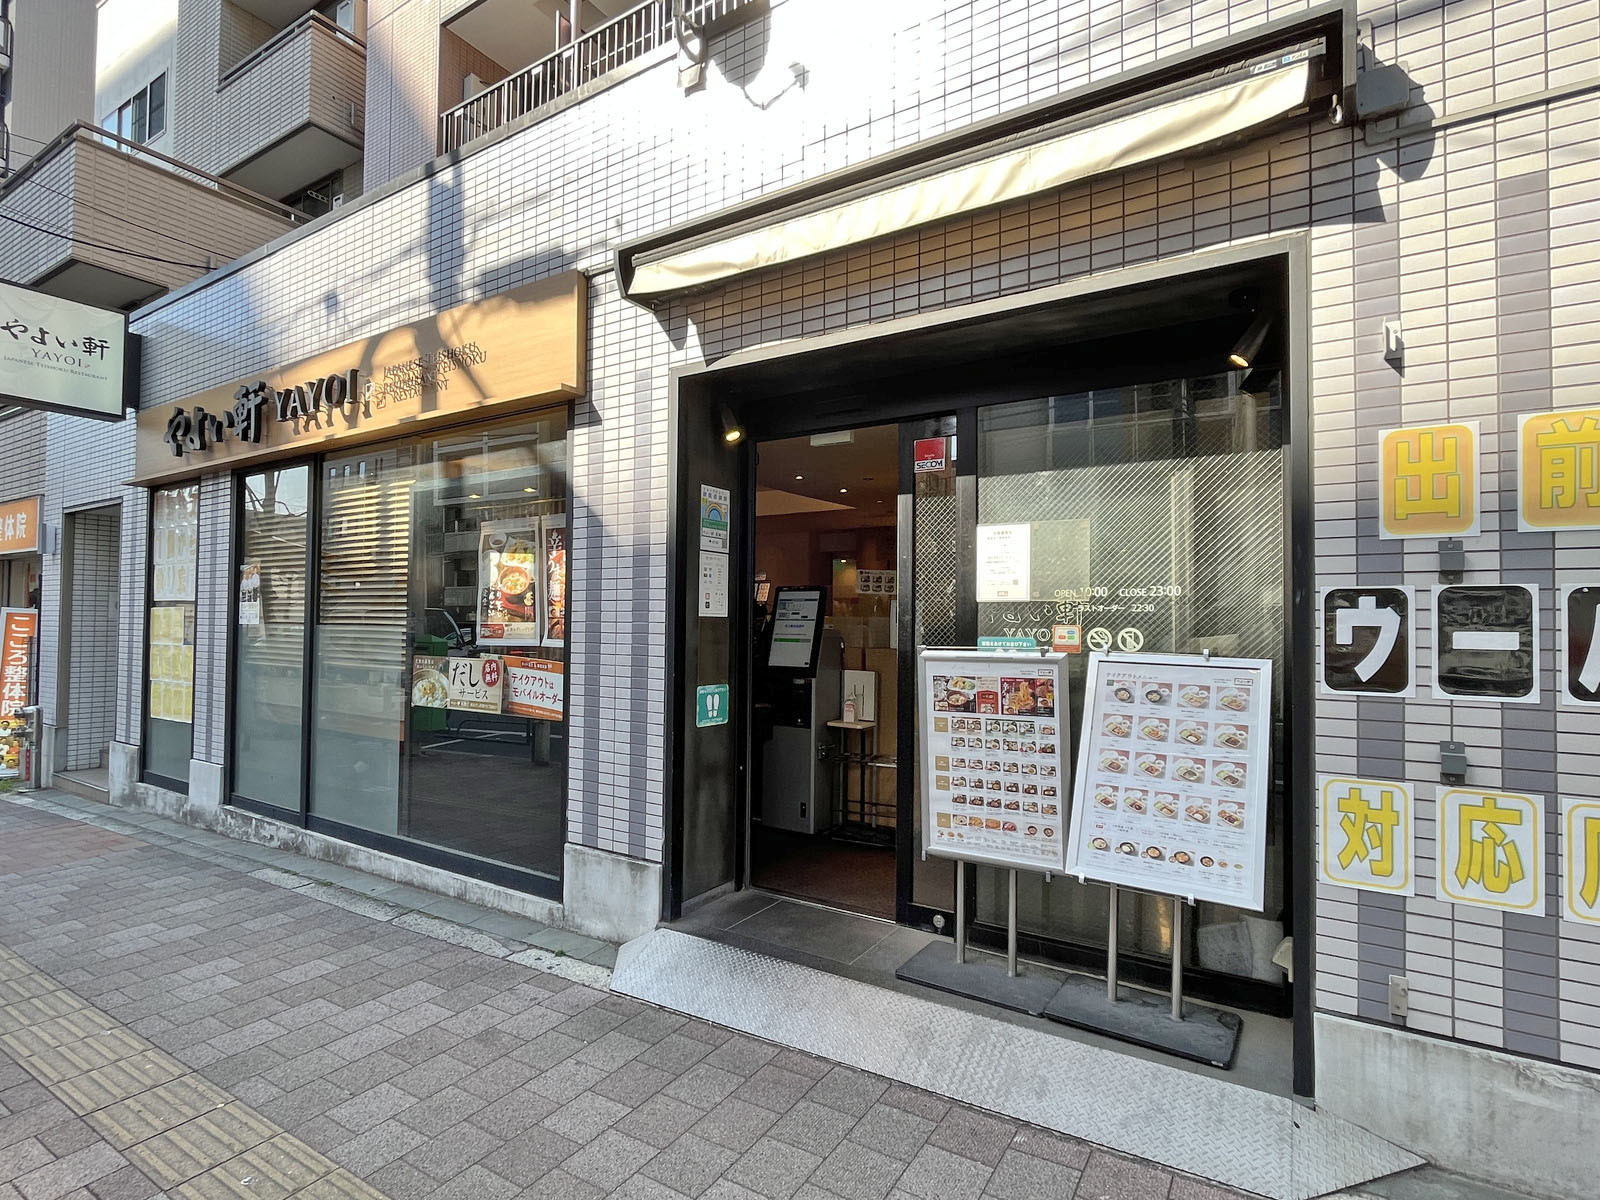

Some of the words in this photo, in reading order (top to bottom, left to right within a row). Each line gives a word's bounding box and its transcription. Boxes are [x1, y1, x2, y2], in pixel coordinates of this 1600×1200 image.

[0, 318, 111, 361] やよい軒
[31, 347, 82, 368] YAYOI
[271, 368, 361, 423] YAYOI
[916, 460, 943, 470] SECOM
[1054, 588, 1077, 598] OPEN
[1080, 587, 1109, 598] 10:00
[1119, 587, 1148, 597] CLOSE
[1149, 585, 1182, 597] 23:00
[1003, 627, 1054, 642] YAYO
[1, 615, 31, 718] こころ整体院
[452, 662, 480, 688] だし
[511, 672, 555, 690] テイクアウトは
[458, 688, 489, 700] サービス
[511, 687, 564, 705] モバイルオーダー
